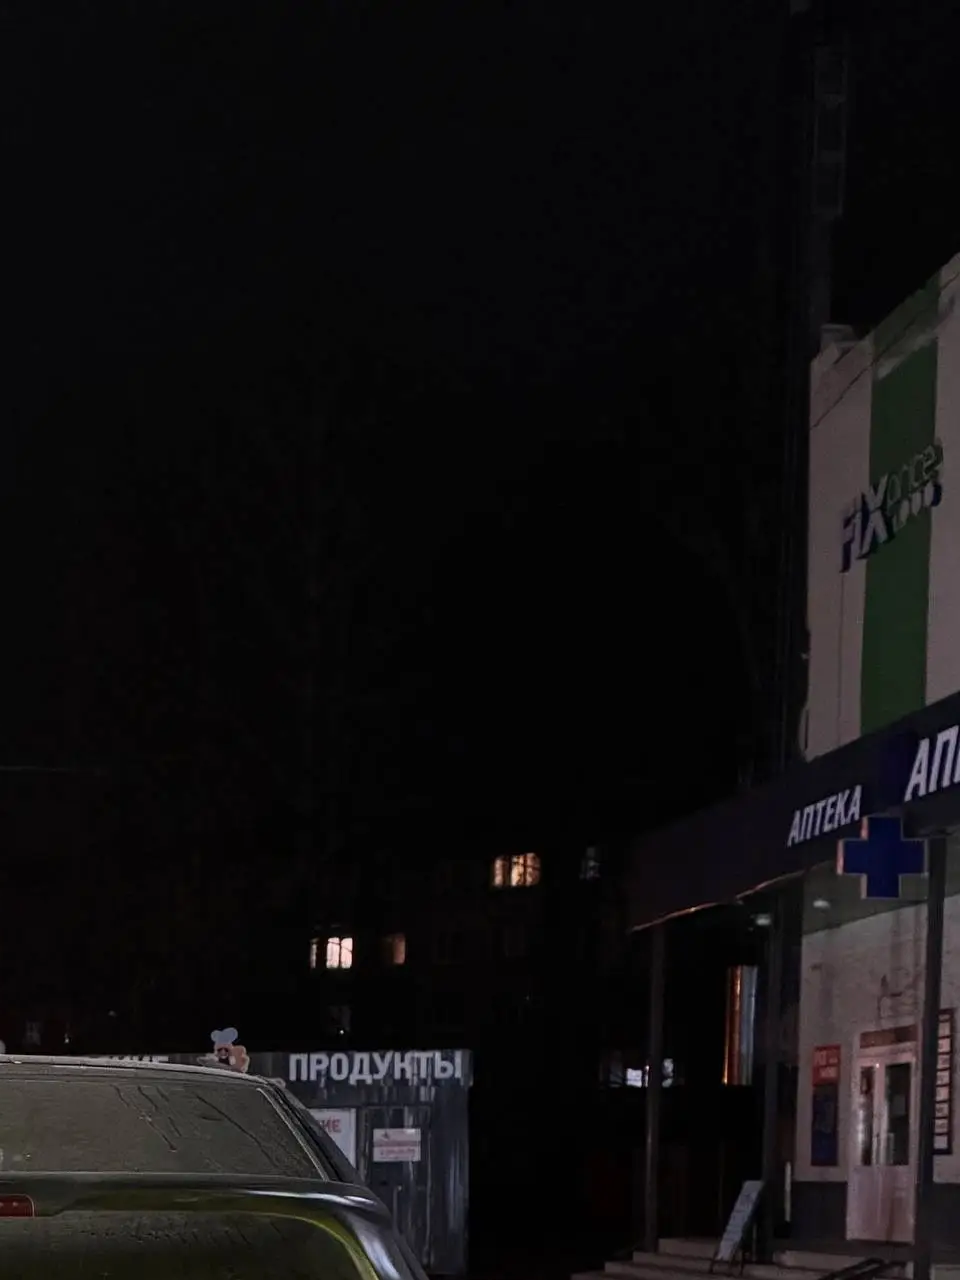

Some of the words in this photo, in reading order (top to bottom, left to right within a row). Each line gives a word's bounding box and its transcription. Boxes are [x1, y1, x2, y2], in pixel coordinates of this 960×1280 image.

[903, 724, 960, 803] АП
[786, 784, 863, 849] АПТЕКА
[288, 1050, 463, 1086] ПРОДУКТЫ
